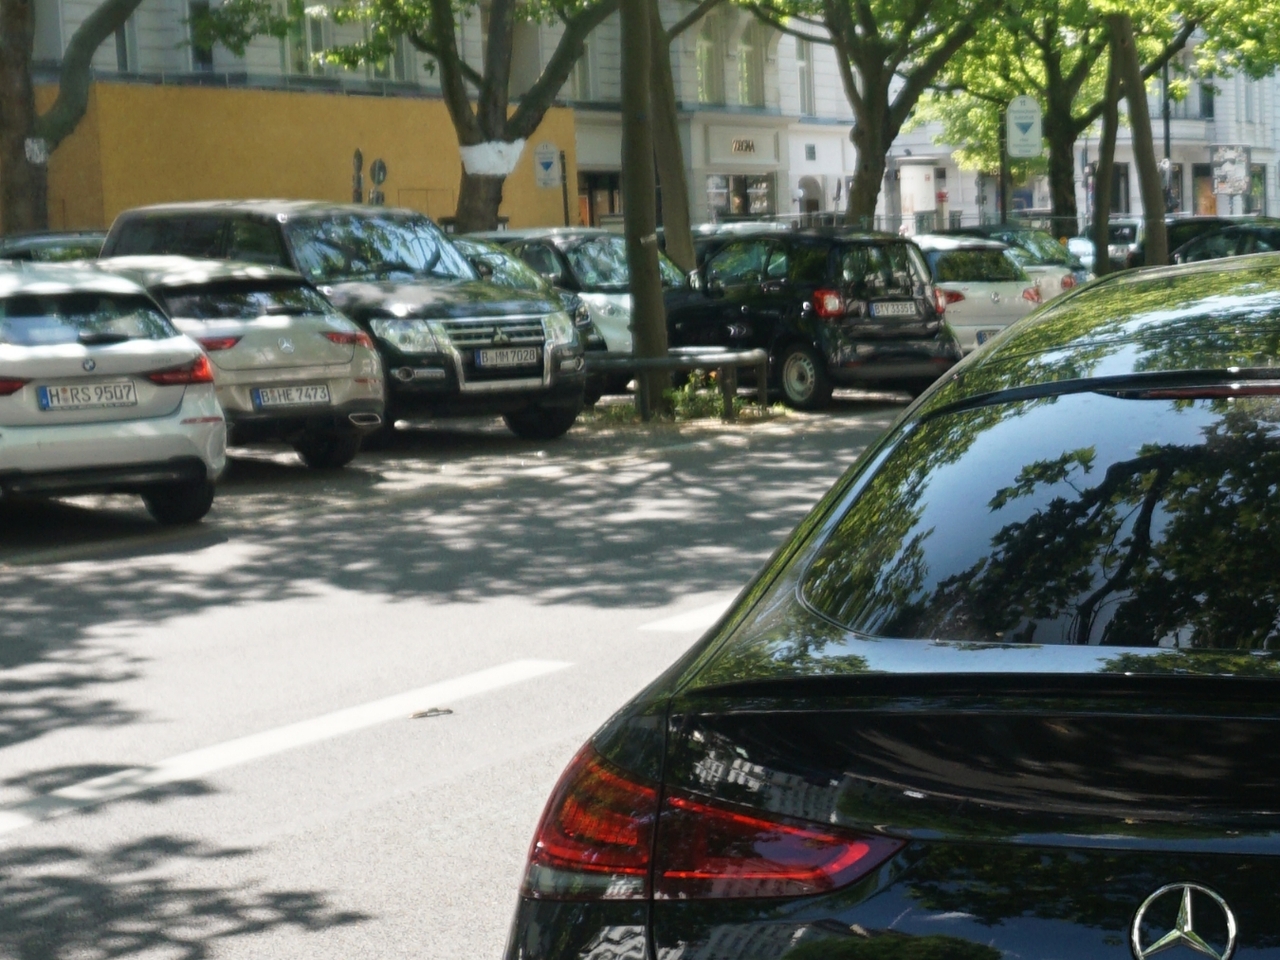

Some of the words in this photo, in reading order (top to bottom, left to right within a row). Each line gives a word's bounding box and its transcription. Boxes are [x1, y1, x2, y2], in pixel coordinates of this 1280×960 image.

[510, 349, 536, 361] 7028
[49, 387, 61, 405] H
[70, 387, 92, 404] RS
[95, 383, 133, 402] 9507
[260, 390, 270, 403] B
[277, 388, 295, 403] HE
[296, 386, 327, 401] 7473
